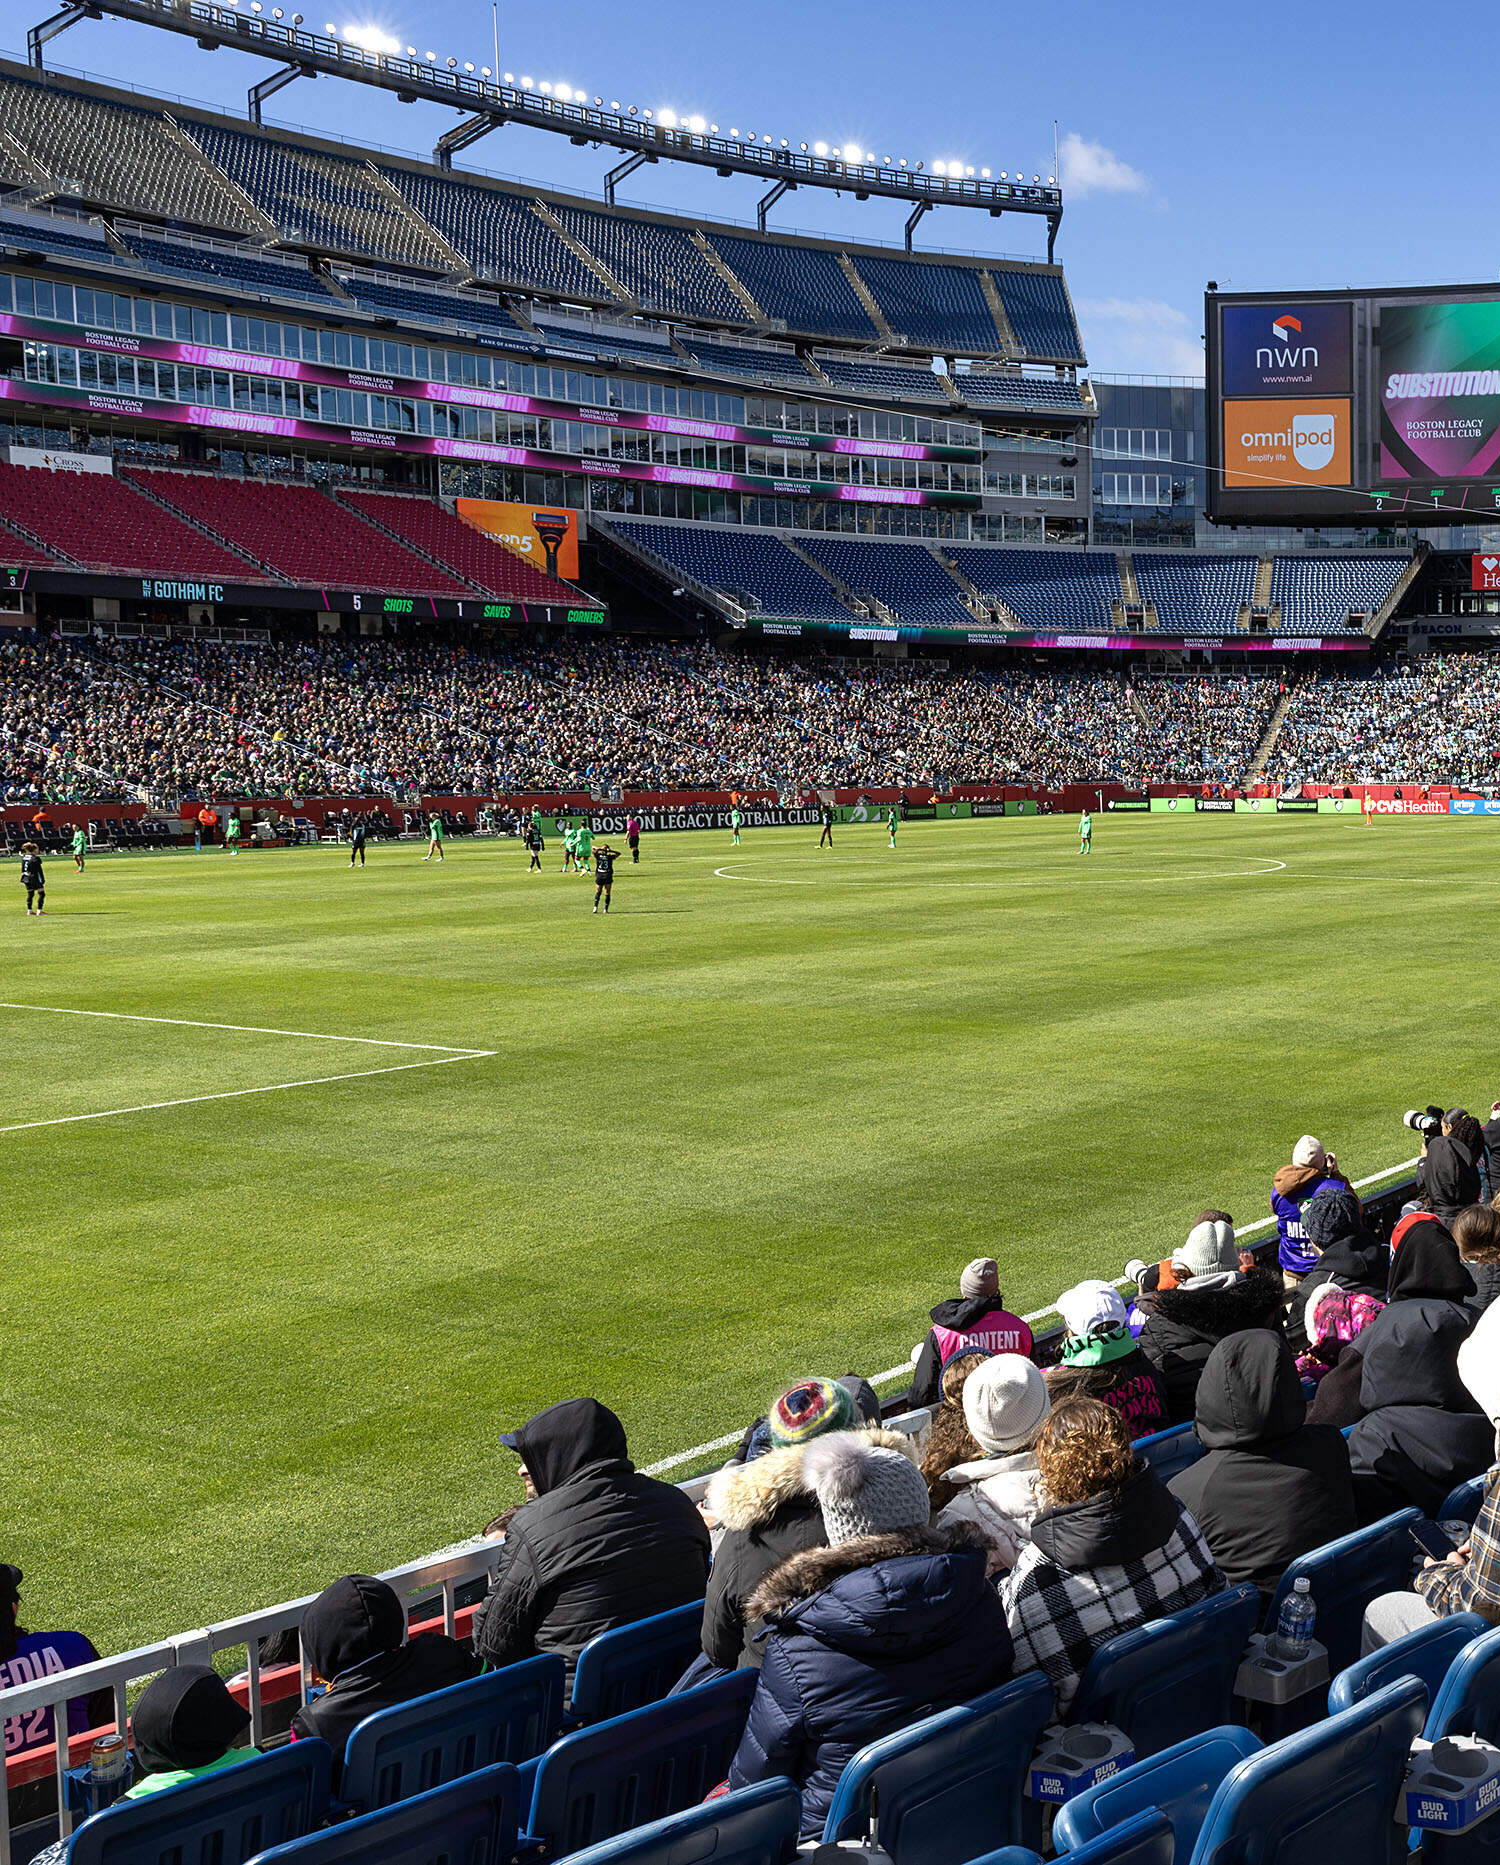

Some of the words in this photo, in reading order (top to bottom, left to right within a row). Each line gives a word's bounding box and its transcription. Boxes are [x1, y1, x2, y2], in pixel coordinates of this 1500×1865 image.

[85, 331, 113, 342] BOSTON
[115, 335, 141, 346] LEGACY
[86, 338, 120, 349] FOOTBALL
[122, 343, 139, 351] CLUB
[207, 351, 272, 373] SUBSTITUTION
[1256, 347, 1319, 368] nwn
[348, 373, 372, 382] BOSTON
[373, 376, 394, 385] LEGACY
[349, 379, 378, 389] FOOTBALL
[379, 383, 394, 391] CLUB
[1262, 374, 1313, 384] www.nwn.ai
[89, 394, 116, 405] BOSTON
[118, 397, 144, 408] LEGACY
[90, 400, 124, 411] FOOTBALL
[125, 405, 143, 414] CLUB
[210, 412, 274, 432] SUBSTITUTION
[1407, 421, 1446, 430] BOSTON
[1448, 419, 1484, 429] LEGACY
[351, 430, 374, 439] BOSTON
[375, 433, 397, 441] LEGACY
[1240, 428, 1332, 448] omnipod
[1407, 430, 1456, 440] FOOTBALL
[1457, 429, 1482, 438] CLUB
[351, 435, 381, 445] FOOTBALL
[381, 439, 396, 447] CLUB
[1247, 454, 1274, 463] simplify
[1376, 498, 1383, 510] 2
[1433, 497, 1438, 509] 1
[9, 576, 16, 587] 3
[154, 580, 206, 601] GOTHAM
[208, 584, 224, 602] FC
[353, 594, 361, 611] 5
[383, 597, 414, 614] SHOTS
[457, 602, 463, 617] 1
[483, 604, 511, 619] SAVES
[545, 607, 551, 622] 1
[567, 609, 605, 625] CORNERS
[849, 627, 898, 642] SUBSTITUTION
[1412, 624, 1462, 634] BEACON
[1057, 636, 1108, 648] SUBSTITUTION
[1272, 638, 1322, 649] SUBSTITUTION
[1454, 800, 1476, 810] prime
[660, 812, 714, 829] LEGACY
[788, 809, 820, 824] CLUB
[958, 1329, 1021, 1351] CONTENT
[1094, 1761, 1116, 1778] BUD
[1043, 1777, 1061, 1786] BUD
[1040, 1786, 1065, 1796] LIGHT
[1478, 1777, 1499, 1799] BUD
[1421, 1800, 1444, 1811] BUD
[1417, 1810, 1448, 1821] LIGHT
